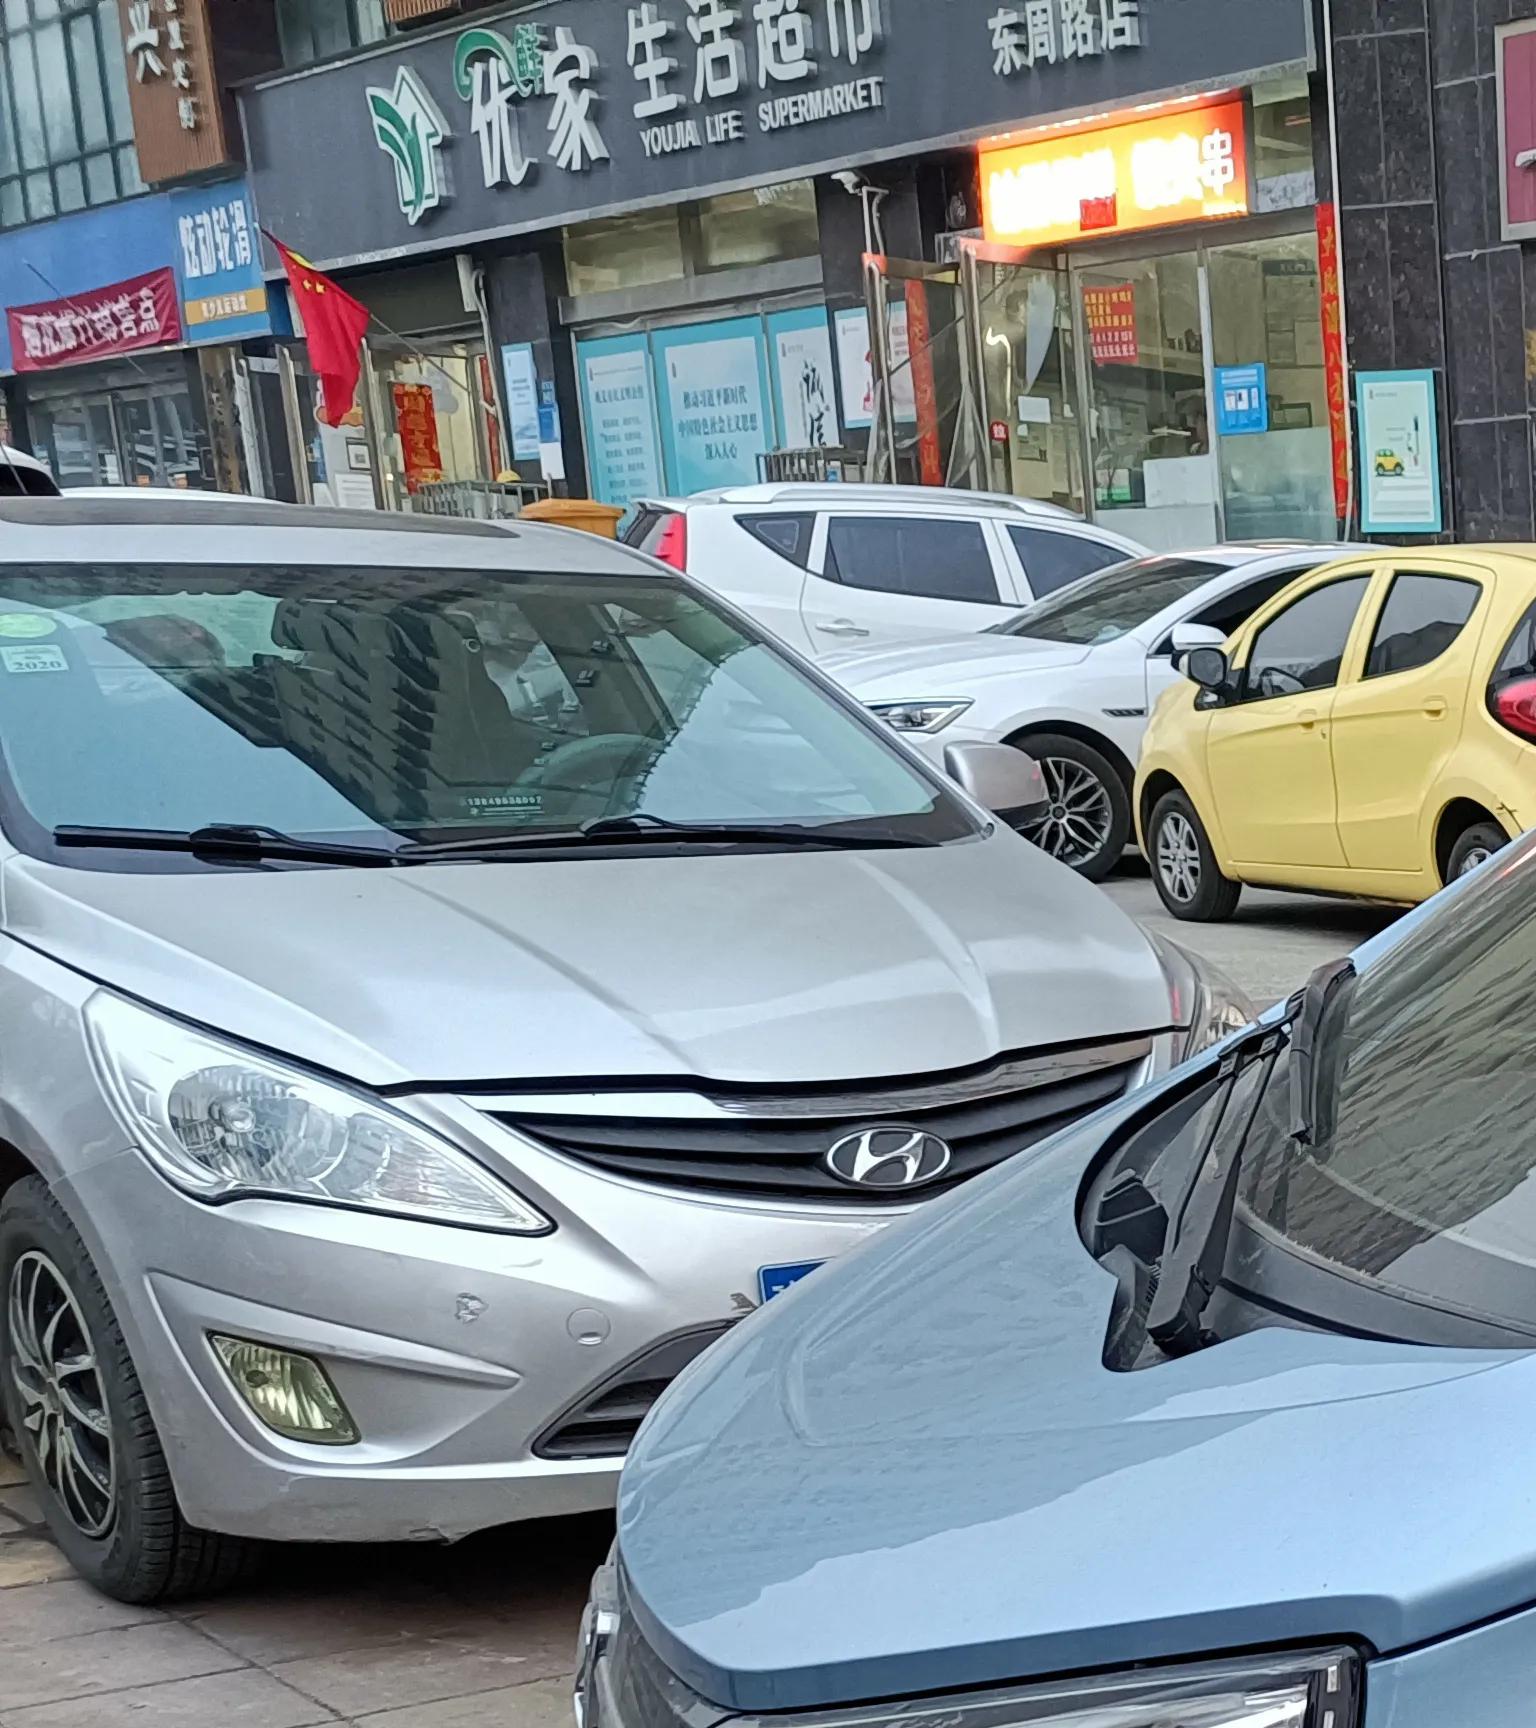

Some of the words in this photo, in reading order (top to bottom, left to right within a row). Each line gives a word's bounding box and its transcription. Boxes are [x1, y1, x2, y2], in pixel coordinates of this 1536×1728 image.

[987, 0, 1143, 76] 东周路店
[470, 26, 610, 188] 优家
[626, 0, 878, 119] 生活超市
[641, 119, 702, 158] YOUJIA
[705, 109, 742, 145] LIFE
[758, 76, 884, 132] SUPERMARKET
[13, 660, 62, 671] 2020
